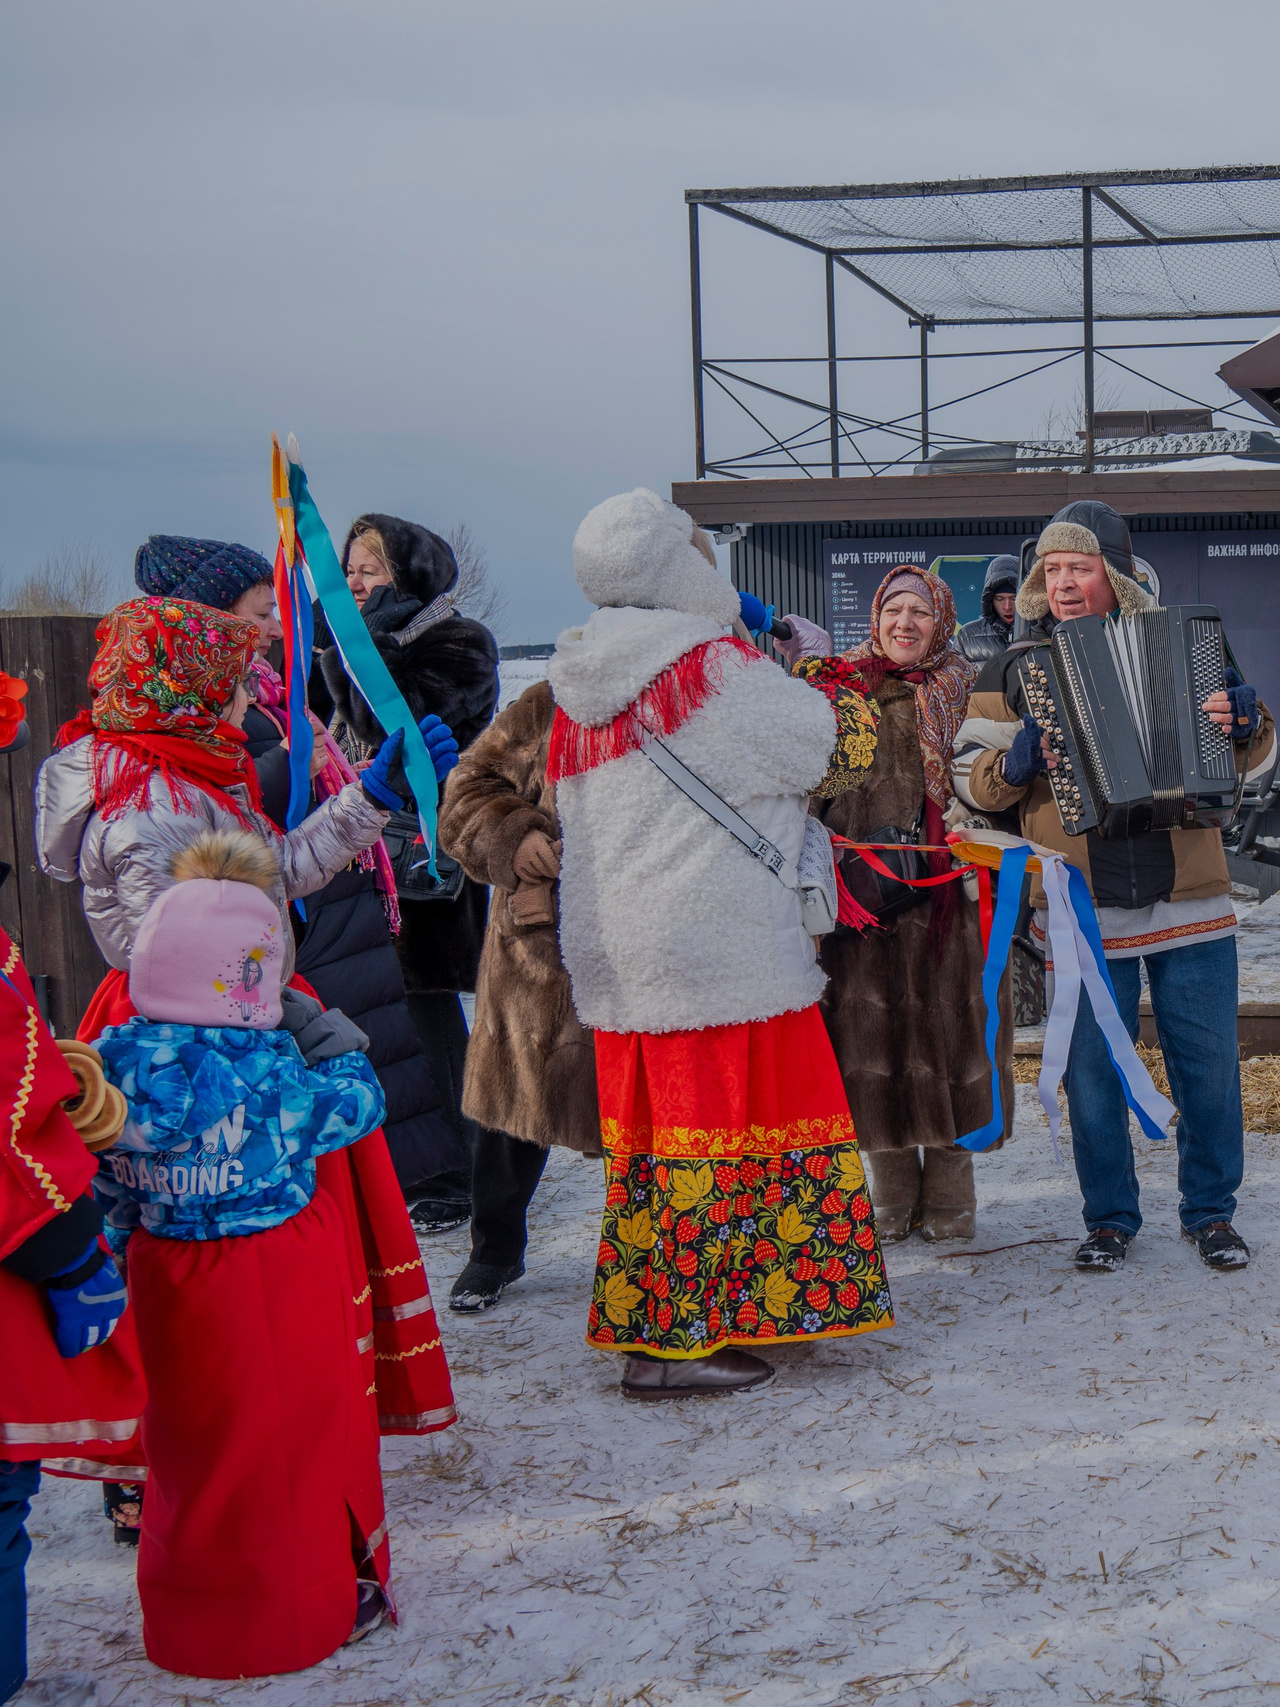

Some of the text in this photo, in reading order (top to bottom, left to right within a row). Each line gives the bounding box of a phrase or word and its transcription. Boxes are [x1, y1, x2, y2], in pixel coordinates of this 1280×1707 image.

[831, 551, 926, 565] КАРТА ТЕРРИТОРИИ
[1207, 545, 1247, 557] ВАЖНАЯ
[108, 1154, 245, 1197] BOARDING
